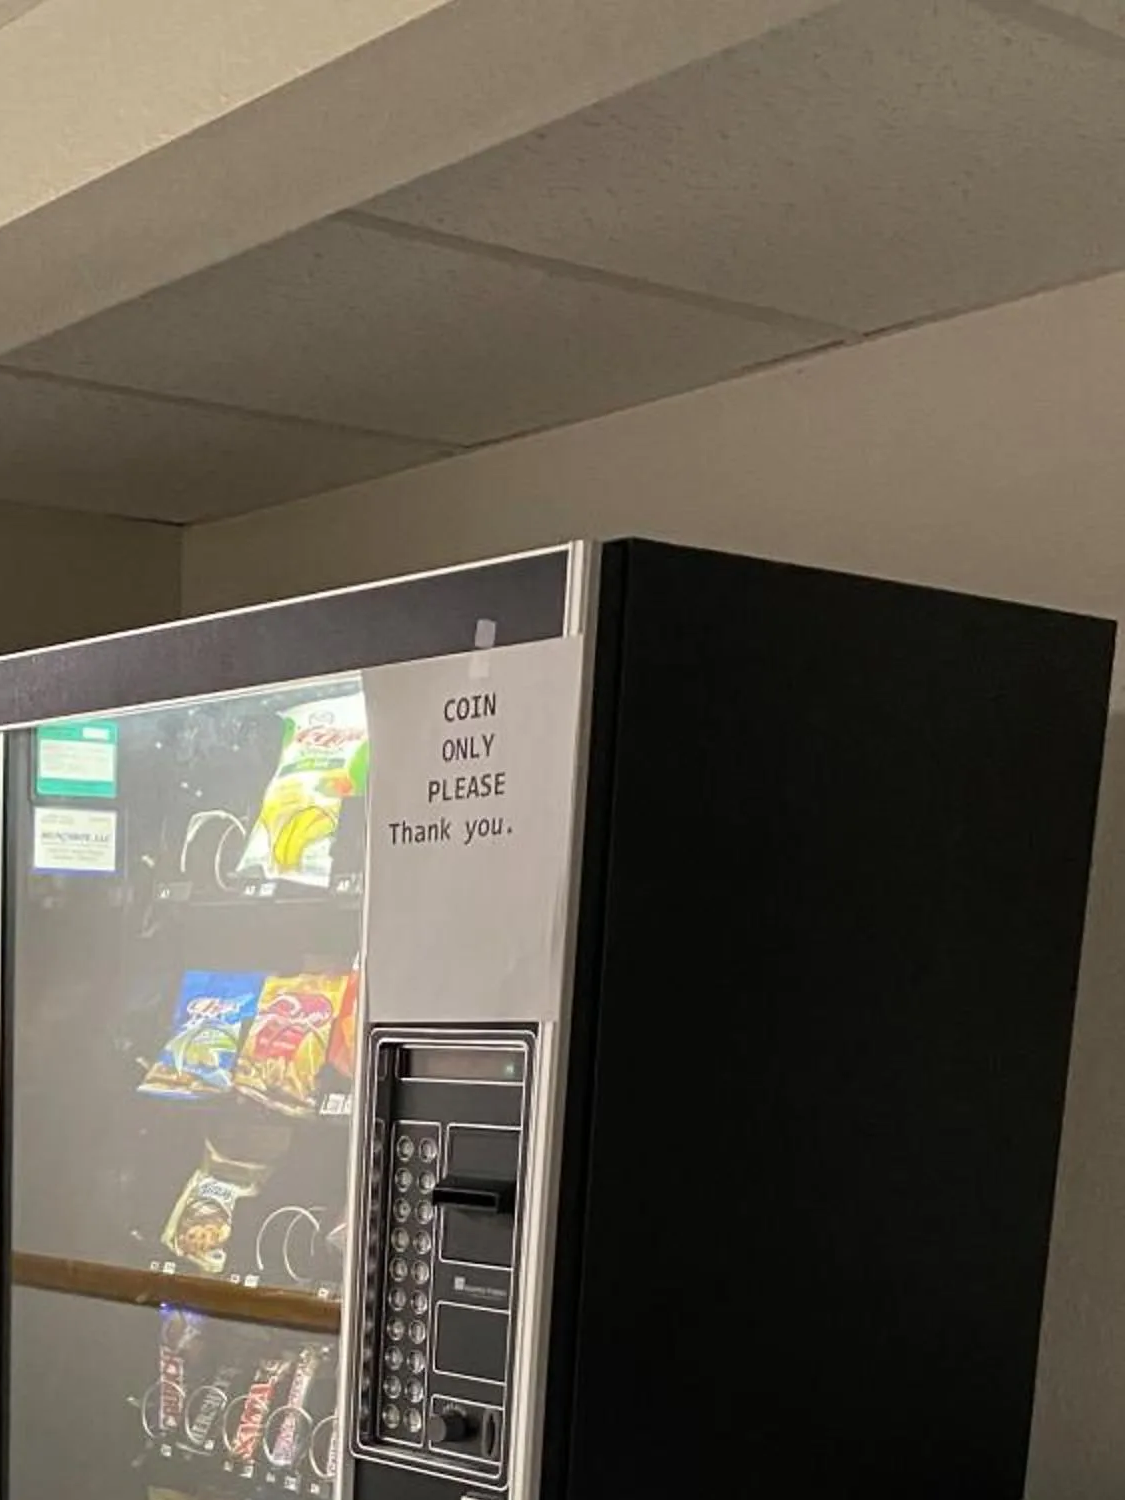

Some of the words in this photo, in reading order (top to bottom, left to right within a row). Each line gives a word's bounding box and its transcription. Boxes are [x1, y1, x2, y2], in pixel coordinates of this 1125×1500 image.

[443, 692, 497, 722] COIN
[442, 733, 496, 762] ONLY
[428, 772, 506, 803] PLEASE
[388, 817, 452, 845] Thank
[464, 817, 513, 845] you.
